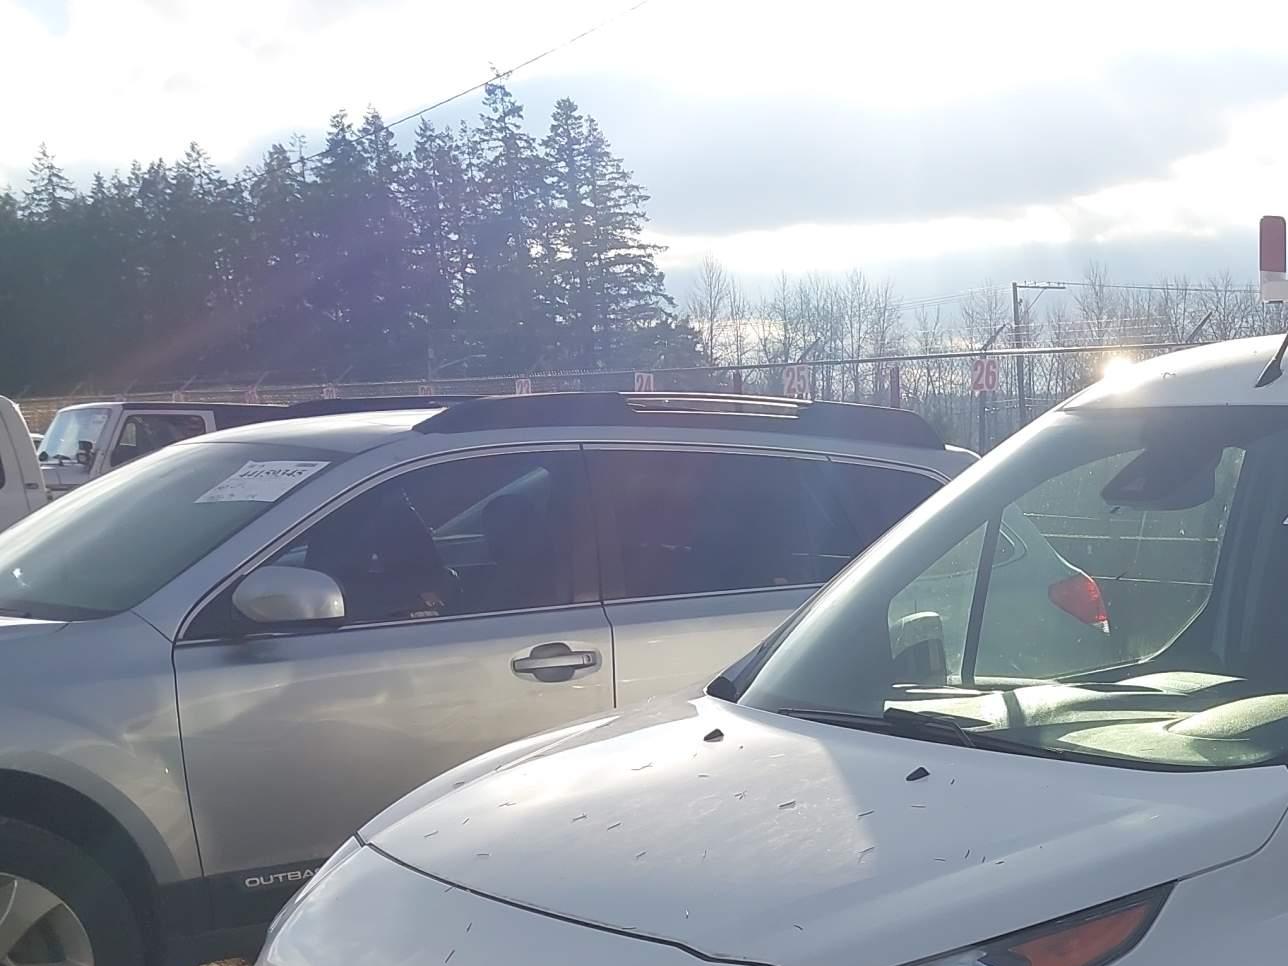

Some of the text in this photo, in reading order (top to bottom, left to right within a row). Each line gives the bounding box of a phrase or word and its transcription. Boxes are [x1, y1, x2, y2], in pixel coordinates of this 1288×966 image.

[785, 366, 807, 393] 25
[972, 359, 997, 390] 26
[244, 867, 320, 888] OUTBA
